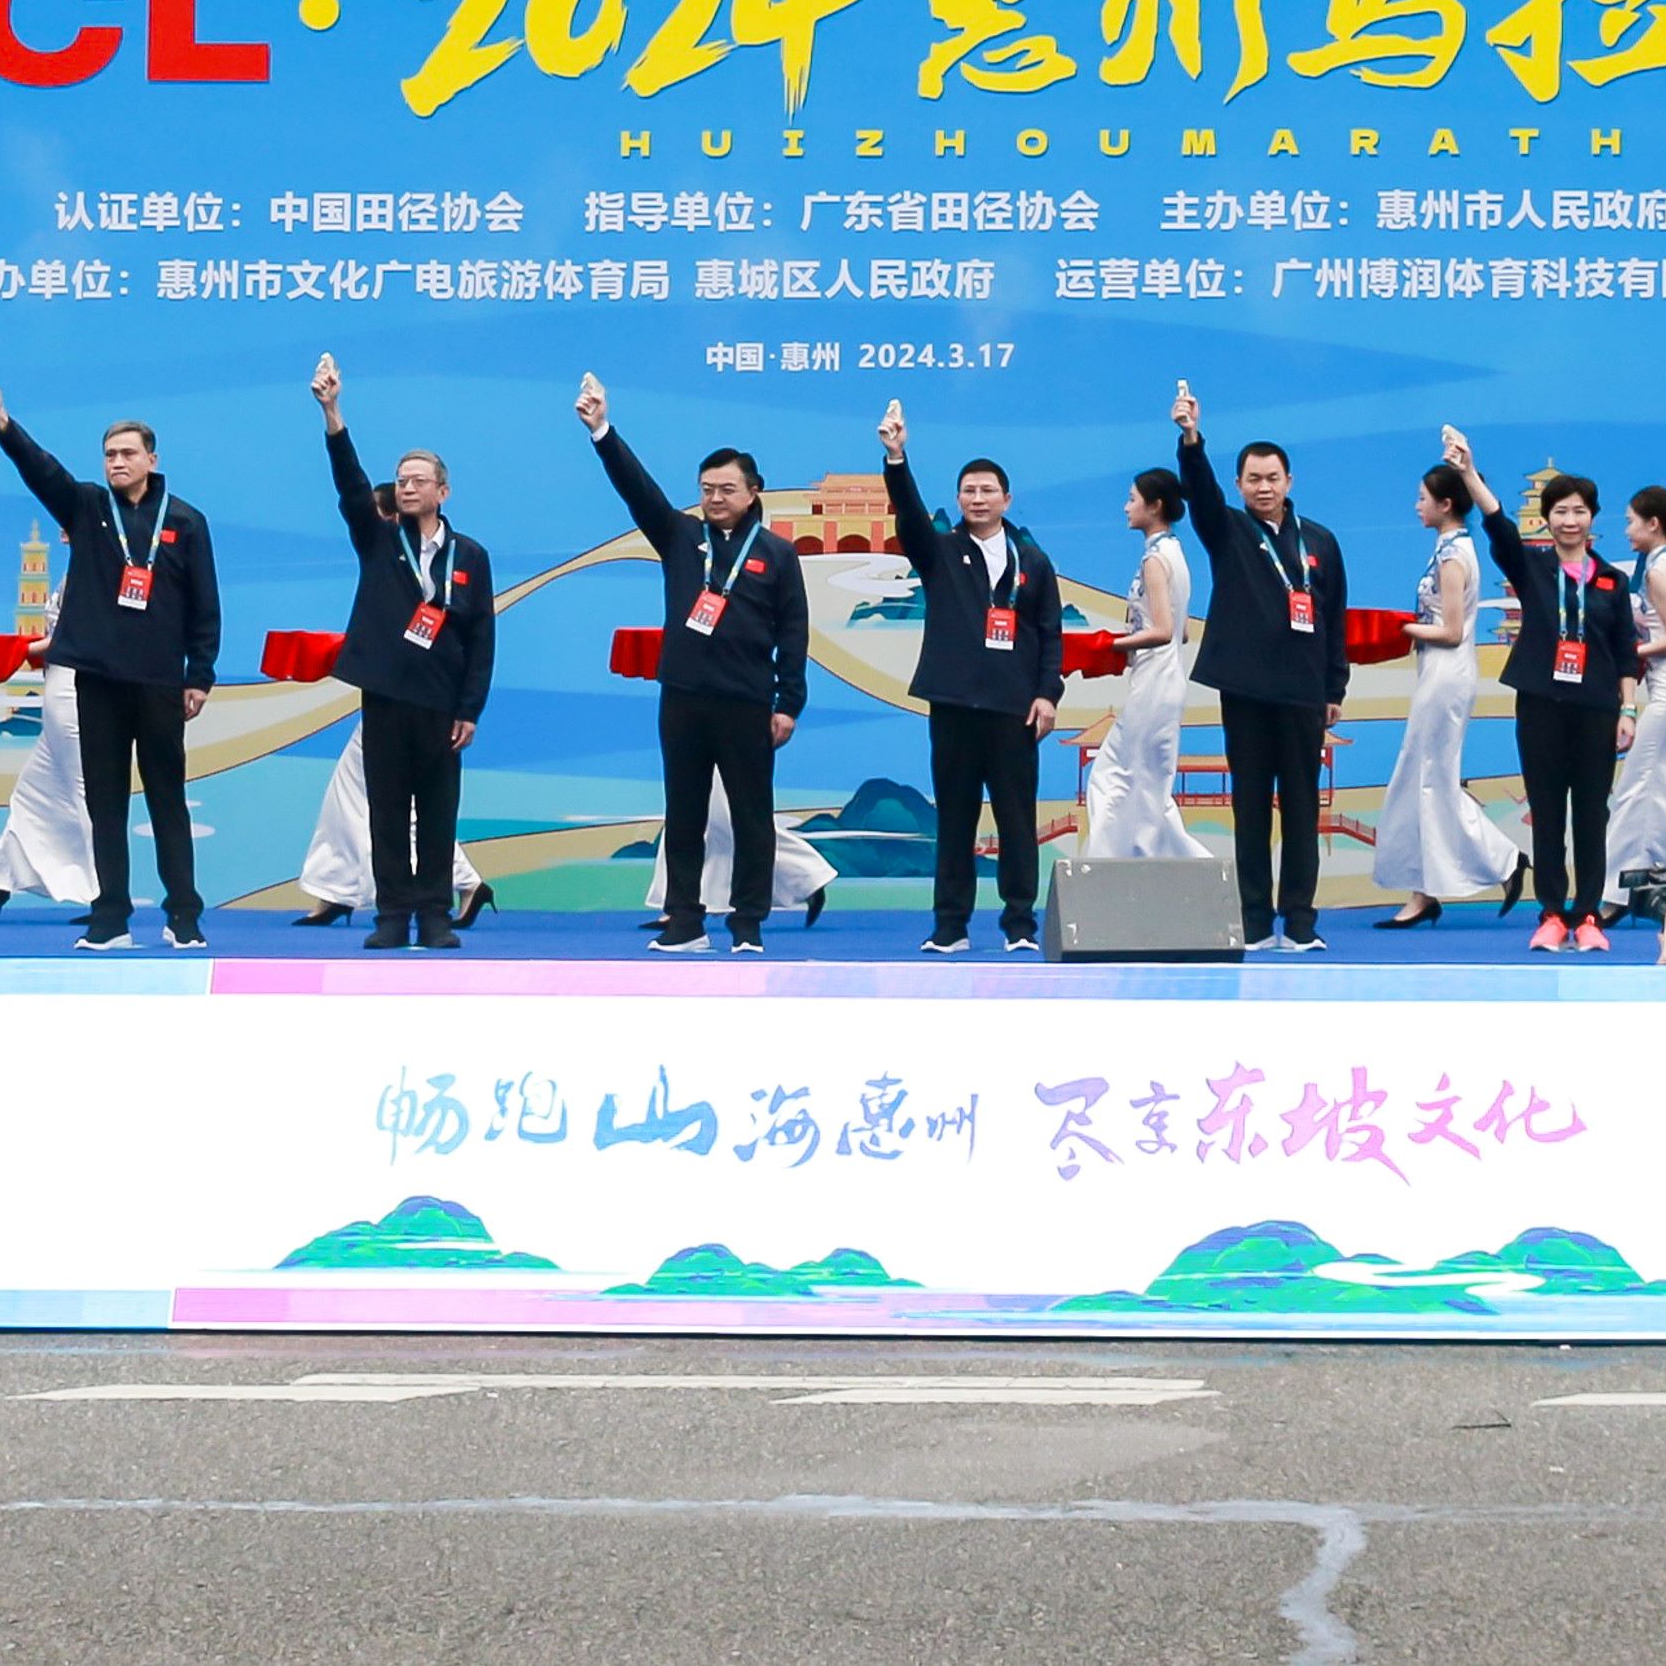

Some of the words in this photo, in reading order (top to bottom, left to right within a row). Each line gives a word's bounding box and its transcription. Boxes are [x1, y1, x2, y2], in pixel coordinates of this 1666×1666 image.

[694, 260, 995, 302] 惠城区人民政府
[705, 342, 841, 373] 中国·惠州
[858, 343, 1015, 370] 2024.3.17
